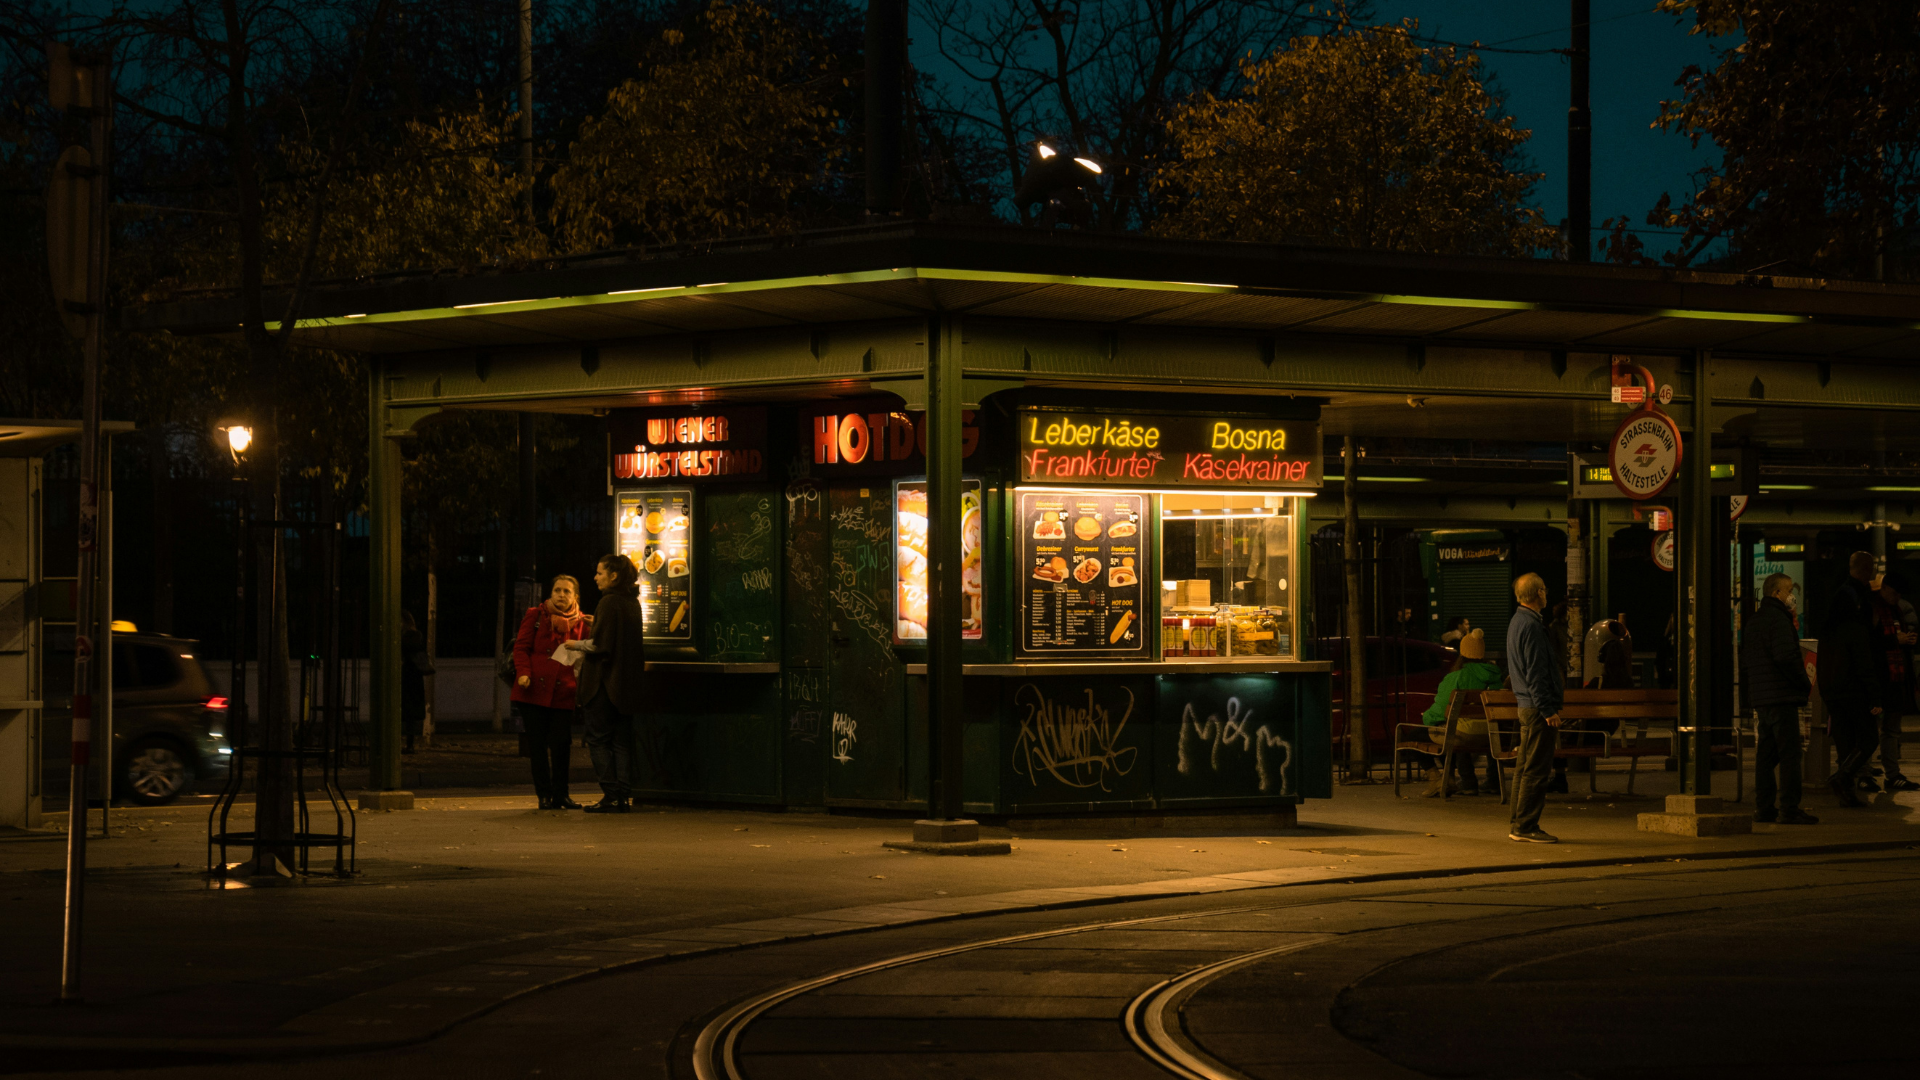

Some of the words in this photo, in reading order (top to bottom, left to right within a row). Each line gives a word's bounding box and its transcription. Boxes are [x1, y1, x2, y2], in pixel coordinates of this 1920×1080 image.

[1660, 388, 1672, 400] 46
[646, 416, 729, 445] WIENER
[1029, 416, 1160, 448] Leberkäse
[1211, 421, 1286, 451] Bosna
[1620, 421, 1674, 452] STRASSENBAHN
[613, 444, 763, 479] WÜRSTELSTAND
[1029, 448, 1161, 478] Frankfurter
[1183, 453, 1310, 481] Käsekrainer
[1619, 462, 1668, 489] HALTESTELLE
[1438, 547, 1463, 560] VOGA
